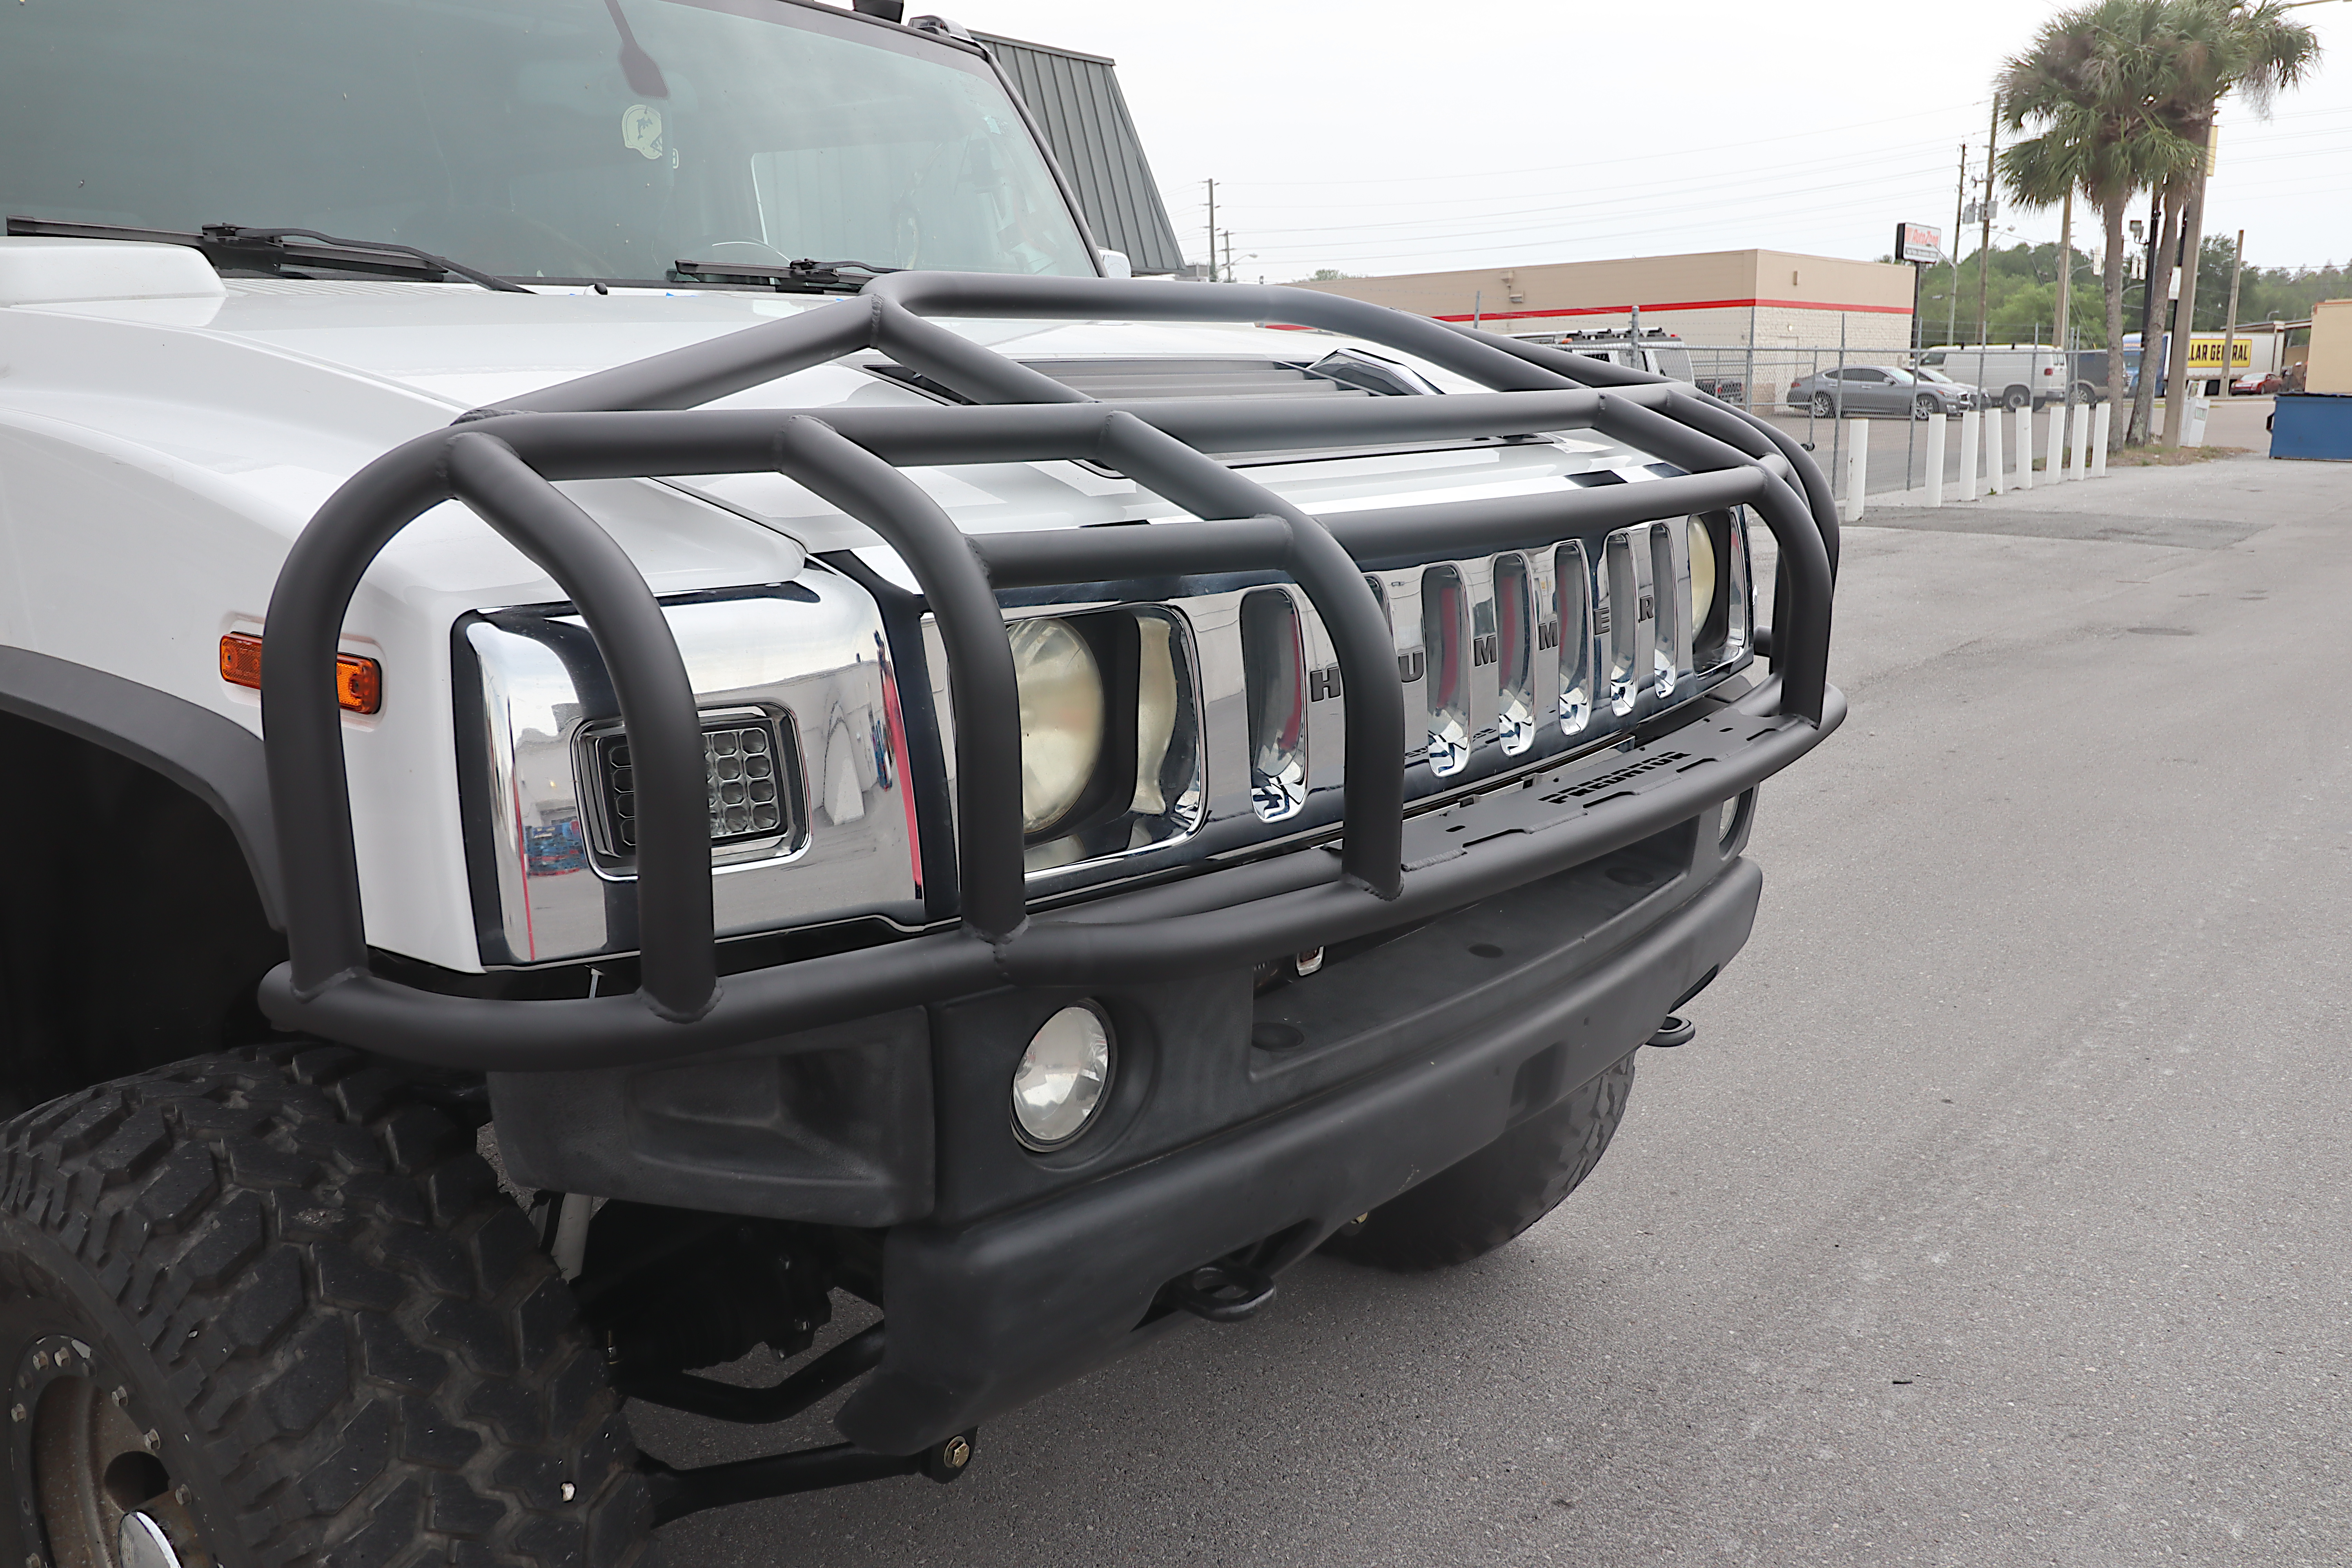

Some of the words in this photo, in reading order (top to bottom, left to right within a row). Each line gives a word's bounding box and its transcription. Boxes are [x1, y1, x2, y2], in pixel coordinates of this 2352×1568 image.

[2188, 344, 2208, 361] LAR
[2210, 344, 2247, 361] GERAL
[1310, 595, 1654, 702] HUMMER
[1537, 751, 1692, 804] PREDATOR
